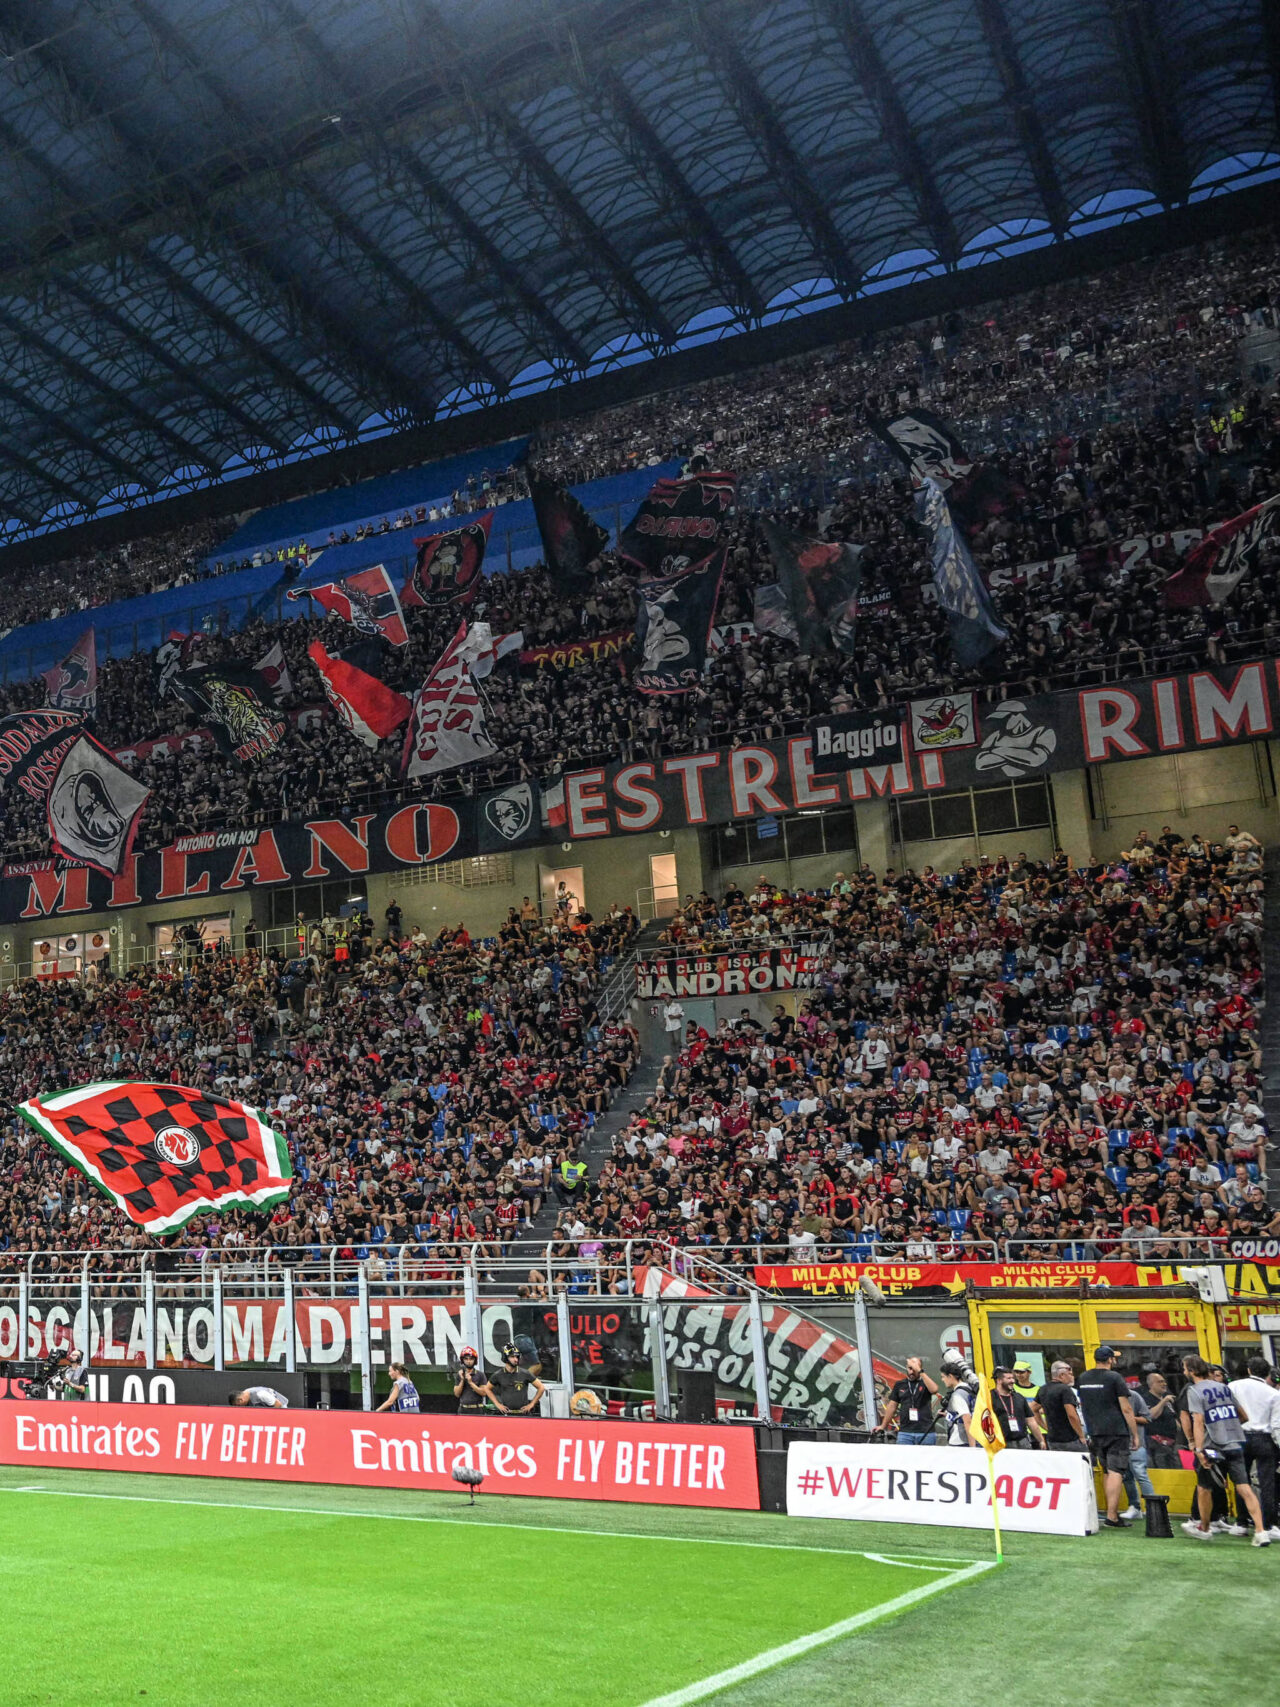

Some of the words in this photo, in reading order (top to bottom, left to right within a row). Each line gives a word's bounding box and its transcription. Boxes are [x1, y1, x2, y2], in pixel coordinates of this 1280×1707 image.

[1078, 659, 1280, 763] RIM
[816, 718, 898, 761] Baggio
[175, 836, 215, 853] ANTONIO
[216, 834, 235, 848] CON
[235, 829, 258, 846] NOI
[7, 860, 52, 876] ASSENTI
[20, 802, 460, 919] MILANO
[676, 962, 712, 974] CLUB
[727, 955, 770, 969] ISOLA
[792, 1267, 861, 1281] MILAN
[863, 1266, 922, 1281] CLUB
[988, 1275, 1109, 1287] PIANEZZA
[1003, 1265, 1052, 1275] MILAN
[1055, 1264, 1097, 1275] CLUB
[844, 1282, 913, 1296] MLE"
[543, 1312, 620, 1335] GULIO
[15, 1415, 161, 1457] Emirates
[175, 1421, 214, 1461] FLY
[219, 1424, 306, 1467] BETTER
[351, 1430, 538, 1478] Emirates
[556, 1437, 605, 1483] FLY
[615, 1440, 726, 1491] BETTER
[797, 1466, 1070, 1511] #WERESPACT
